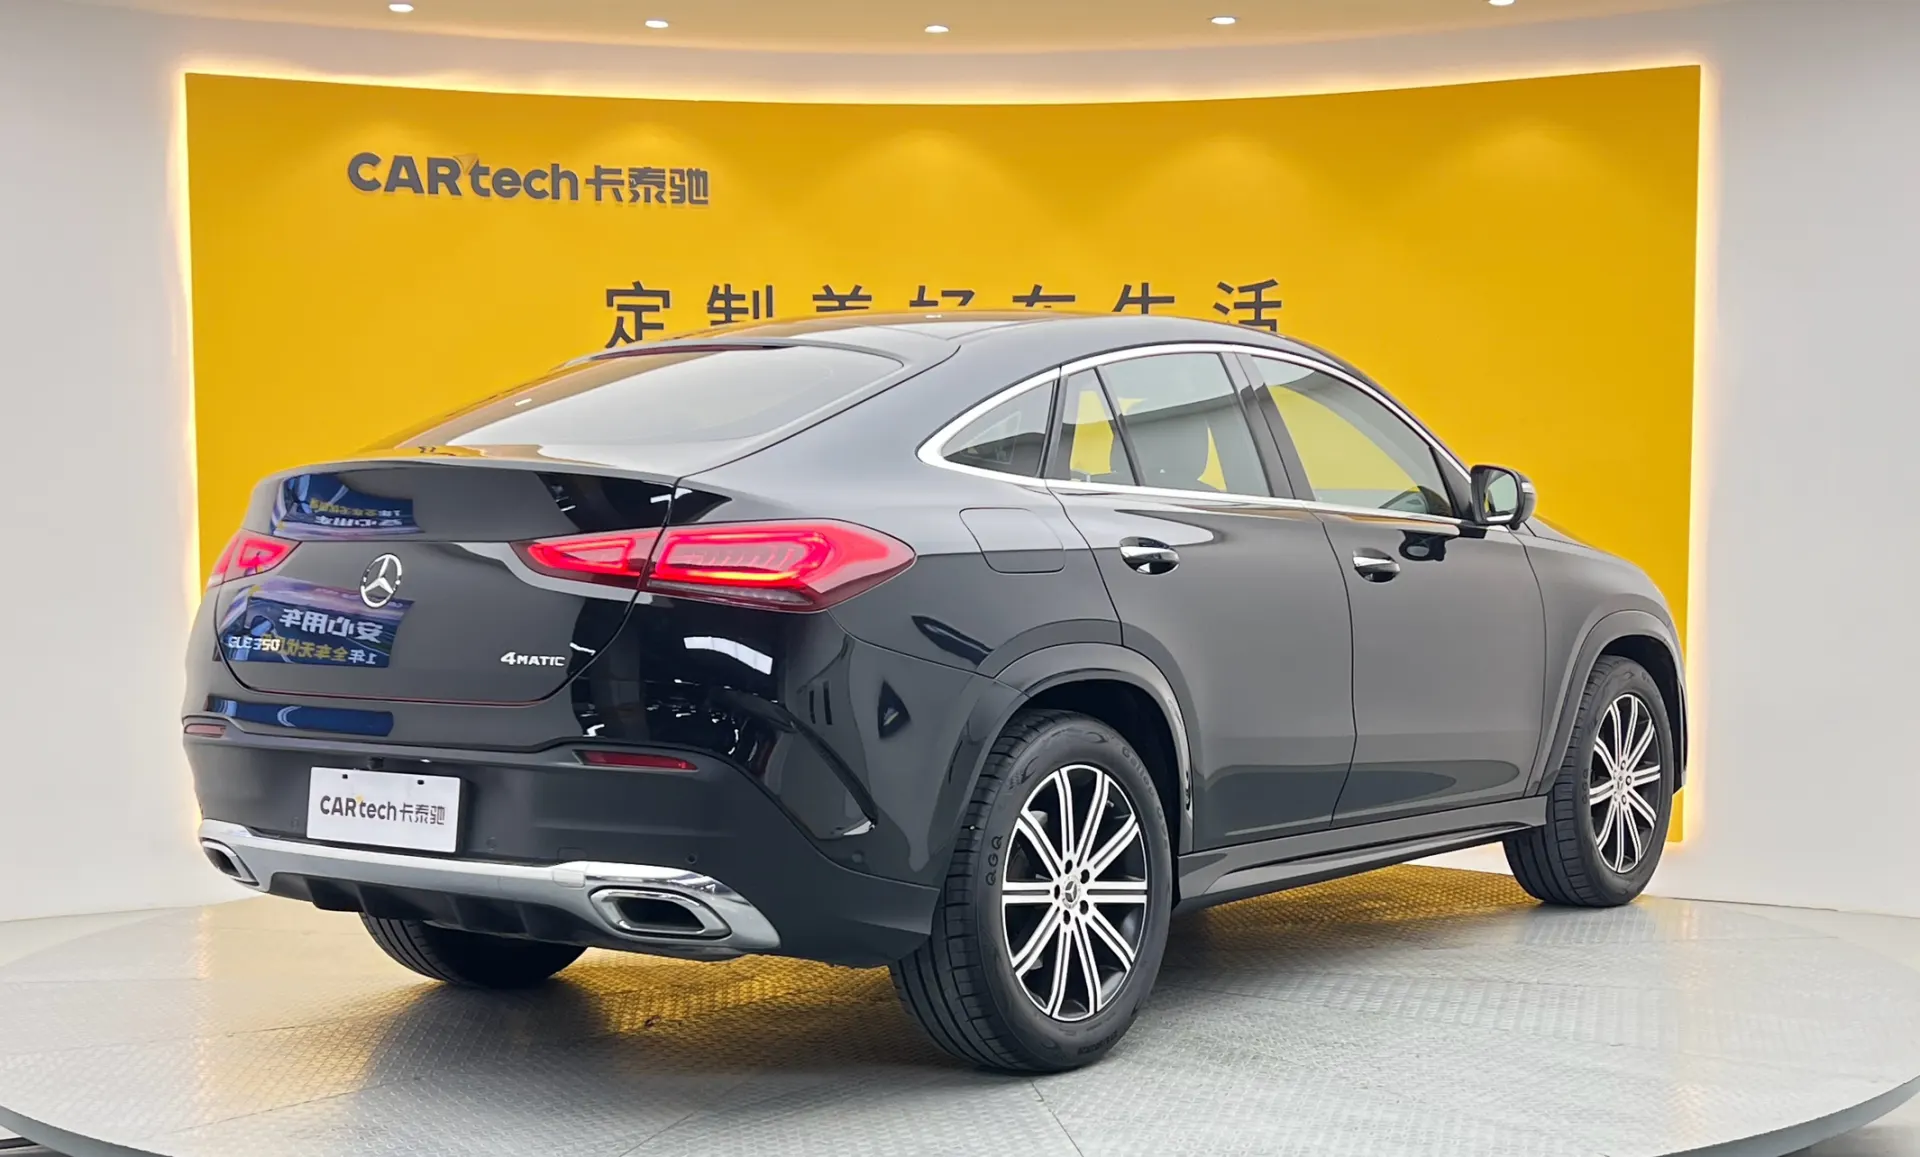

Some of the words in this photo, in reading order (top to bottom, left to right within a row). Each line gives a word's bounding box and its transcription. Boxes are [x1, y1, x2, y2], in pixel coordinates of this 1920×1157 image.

[347, 151, 579, 201] CARtech
[585, 164, 710, 206] 卡泰驰
[500, 651, 566, 667] 4MATIC
[319, 794, 397, 822] CARtech
[399, 802, 447, 826] 卡泰驰
